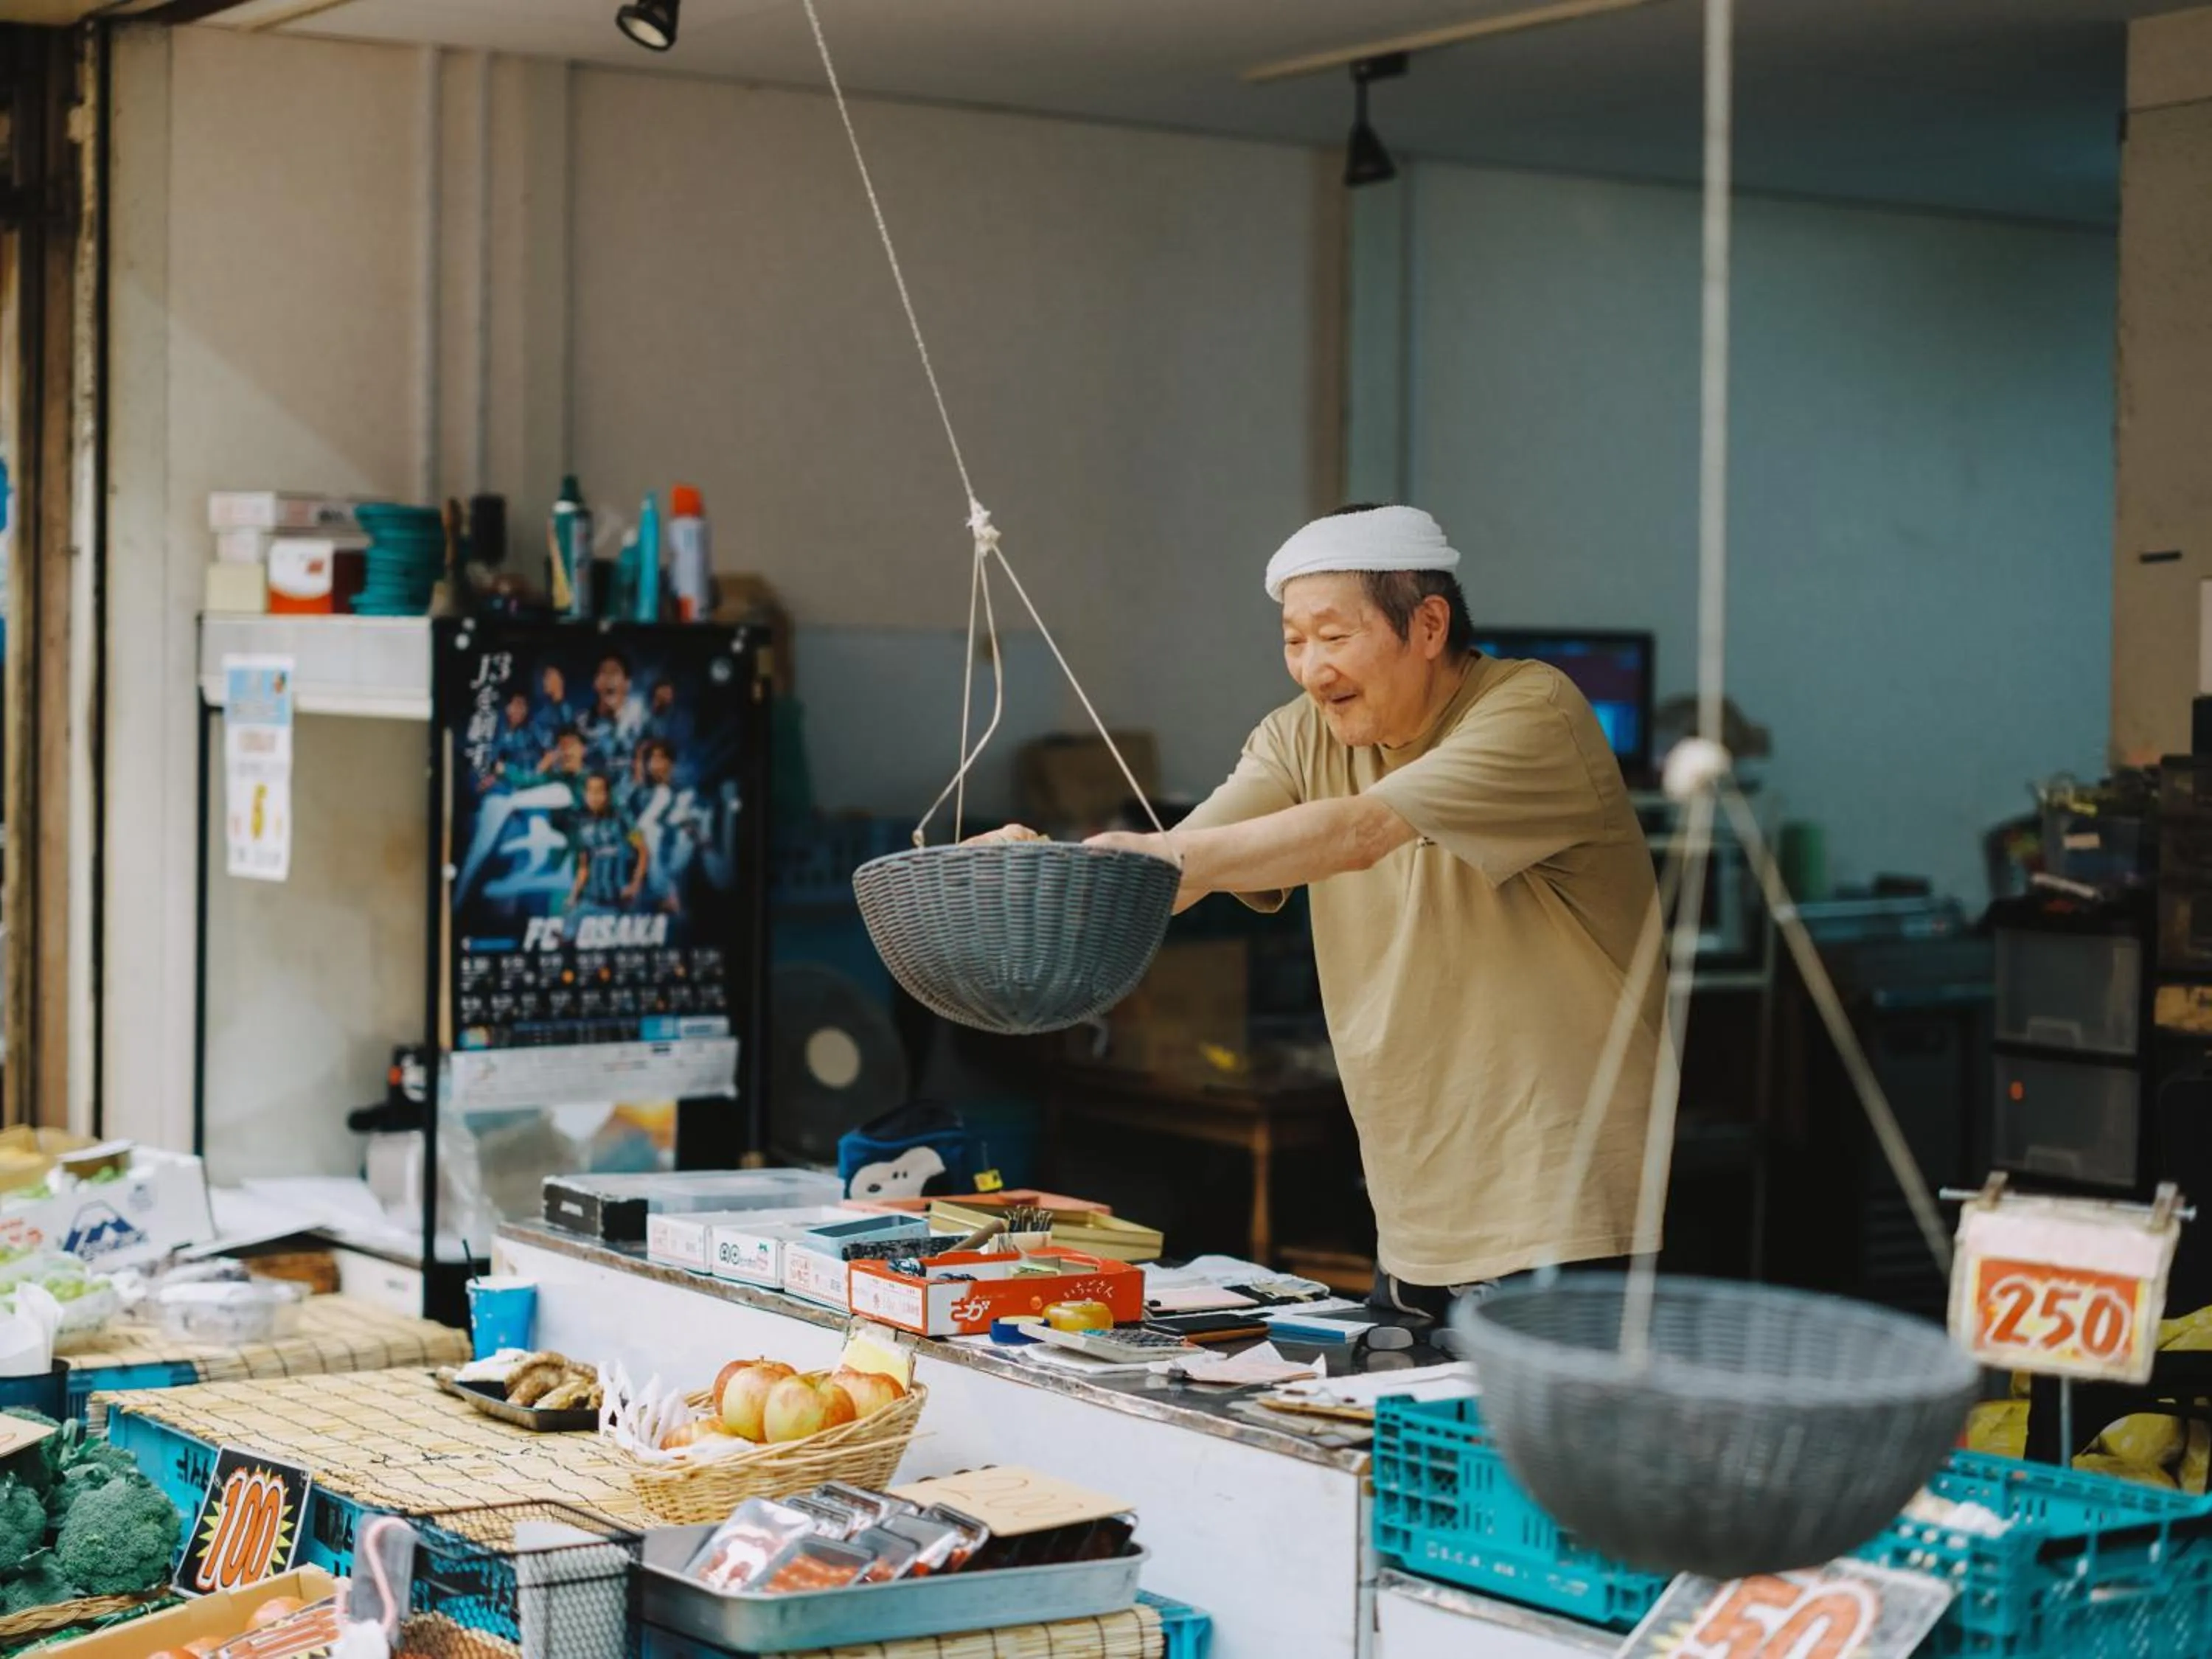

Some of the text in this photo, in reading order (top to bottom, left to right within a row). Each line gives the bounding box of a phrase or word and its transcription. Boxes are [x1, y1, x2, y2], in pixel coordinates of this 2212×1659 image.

[523, 913, 669, 952] FC OSAKA
[1991, 1281, 2125, 1355] 250
[200, 1476, 282, 1588] 100
